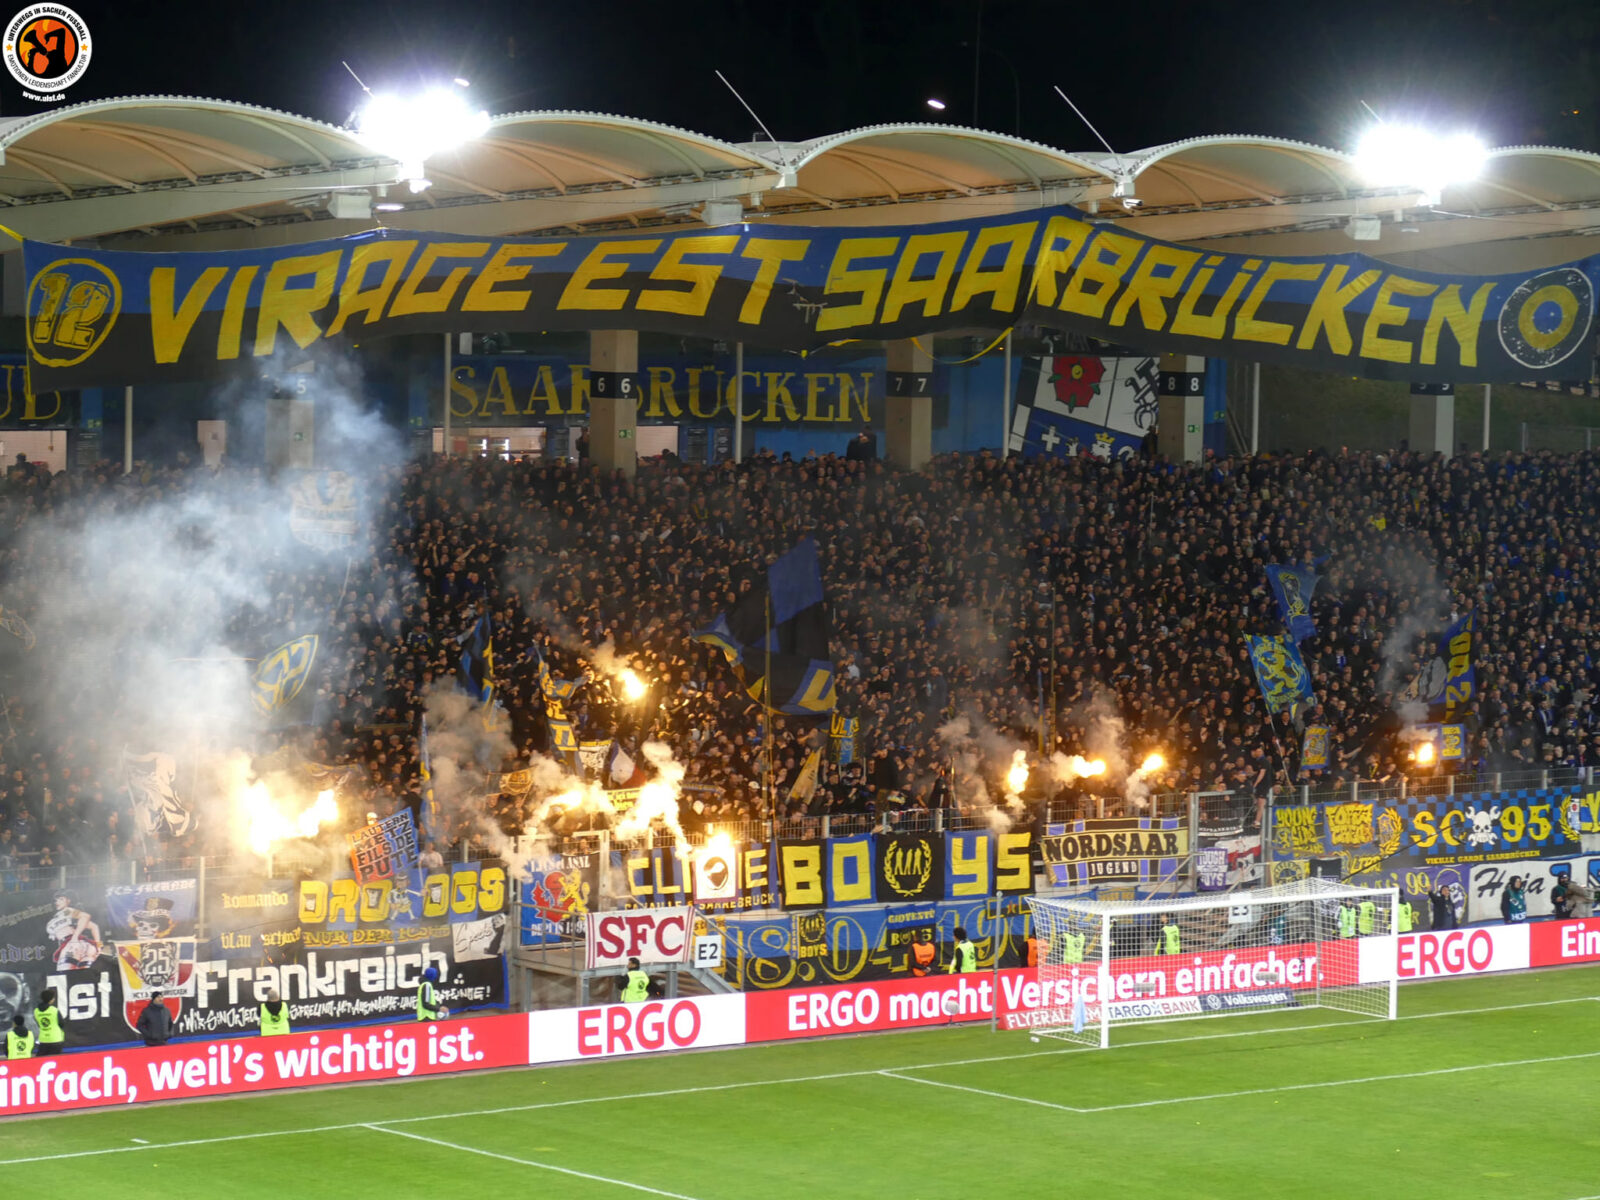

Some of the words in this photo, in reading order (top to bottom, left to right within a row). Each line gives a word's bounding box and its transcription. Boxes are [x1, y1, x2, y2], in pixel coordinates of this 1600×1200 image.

[148, 239, 567, 365] VIRAGE
[556, 234, 811, 325] EST
[814, 214, 1498, 368] SAARBRÜCKEN
[34, 272, 110, 351] 12
[450, 363, 874, 423] SAARRÜCKEN
[597, 377, 605, 393] 6
[620, 377, 632, 394] 6
[917, 377, 928, 393] 7
[1168, 376, 1176, 391] 8
[1190, 377, 1200, 392] 8
[352, 812, 409, 843] LAUTERN
[356, 822, 412, 852] METZ
[1500, 803, 1553, 843] 95
[357, 840, 393, 865] FILS
[394, 831, 415, 850] DE
[1045, 832, 1179, 862] NORDSAAR
[359, 848, 418, 882] PUTE
[627, 849, 768, 896] CLIE
[1091, 861, 1138, 876] JUGEND
[303, 929, 348, 949] NUR
[352, 928, 393, 946] DER
[597, 914, 685, 959] SFC
[700, 942, 719, 960] E2
[800, 943, 829, 959] BOYS
[144, 948, 170, 975] 25
[1396, 929, 1494, 979] ERGO
[788, 988, 880, 1032] ERGO
[889, 978, 993, 1022] macht
[1001, 965, 1167, 1011] Versichern
[1175, 950, 1325, 993] einfacher.
[1223, 991, 1288, 1008] Volkswagen
[577, 998, 702, 1057] ERGO
[276, 1029, 417, 1077] wichtig
[427, 1026, 485, 1065] ist.
